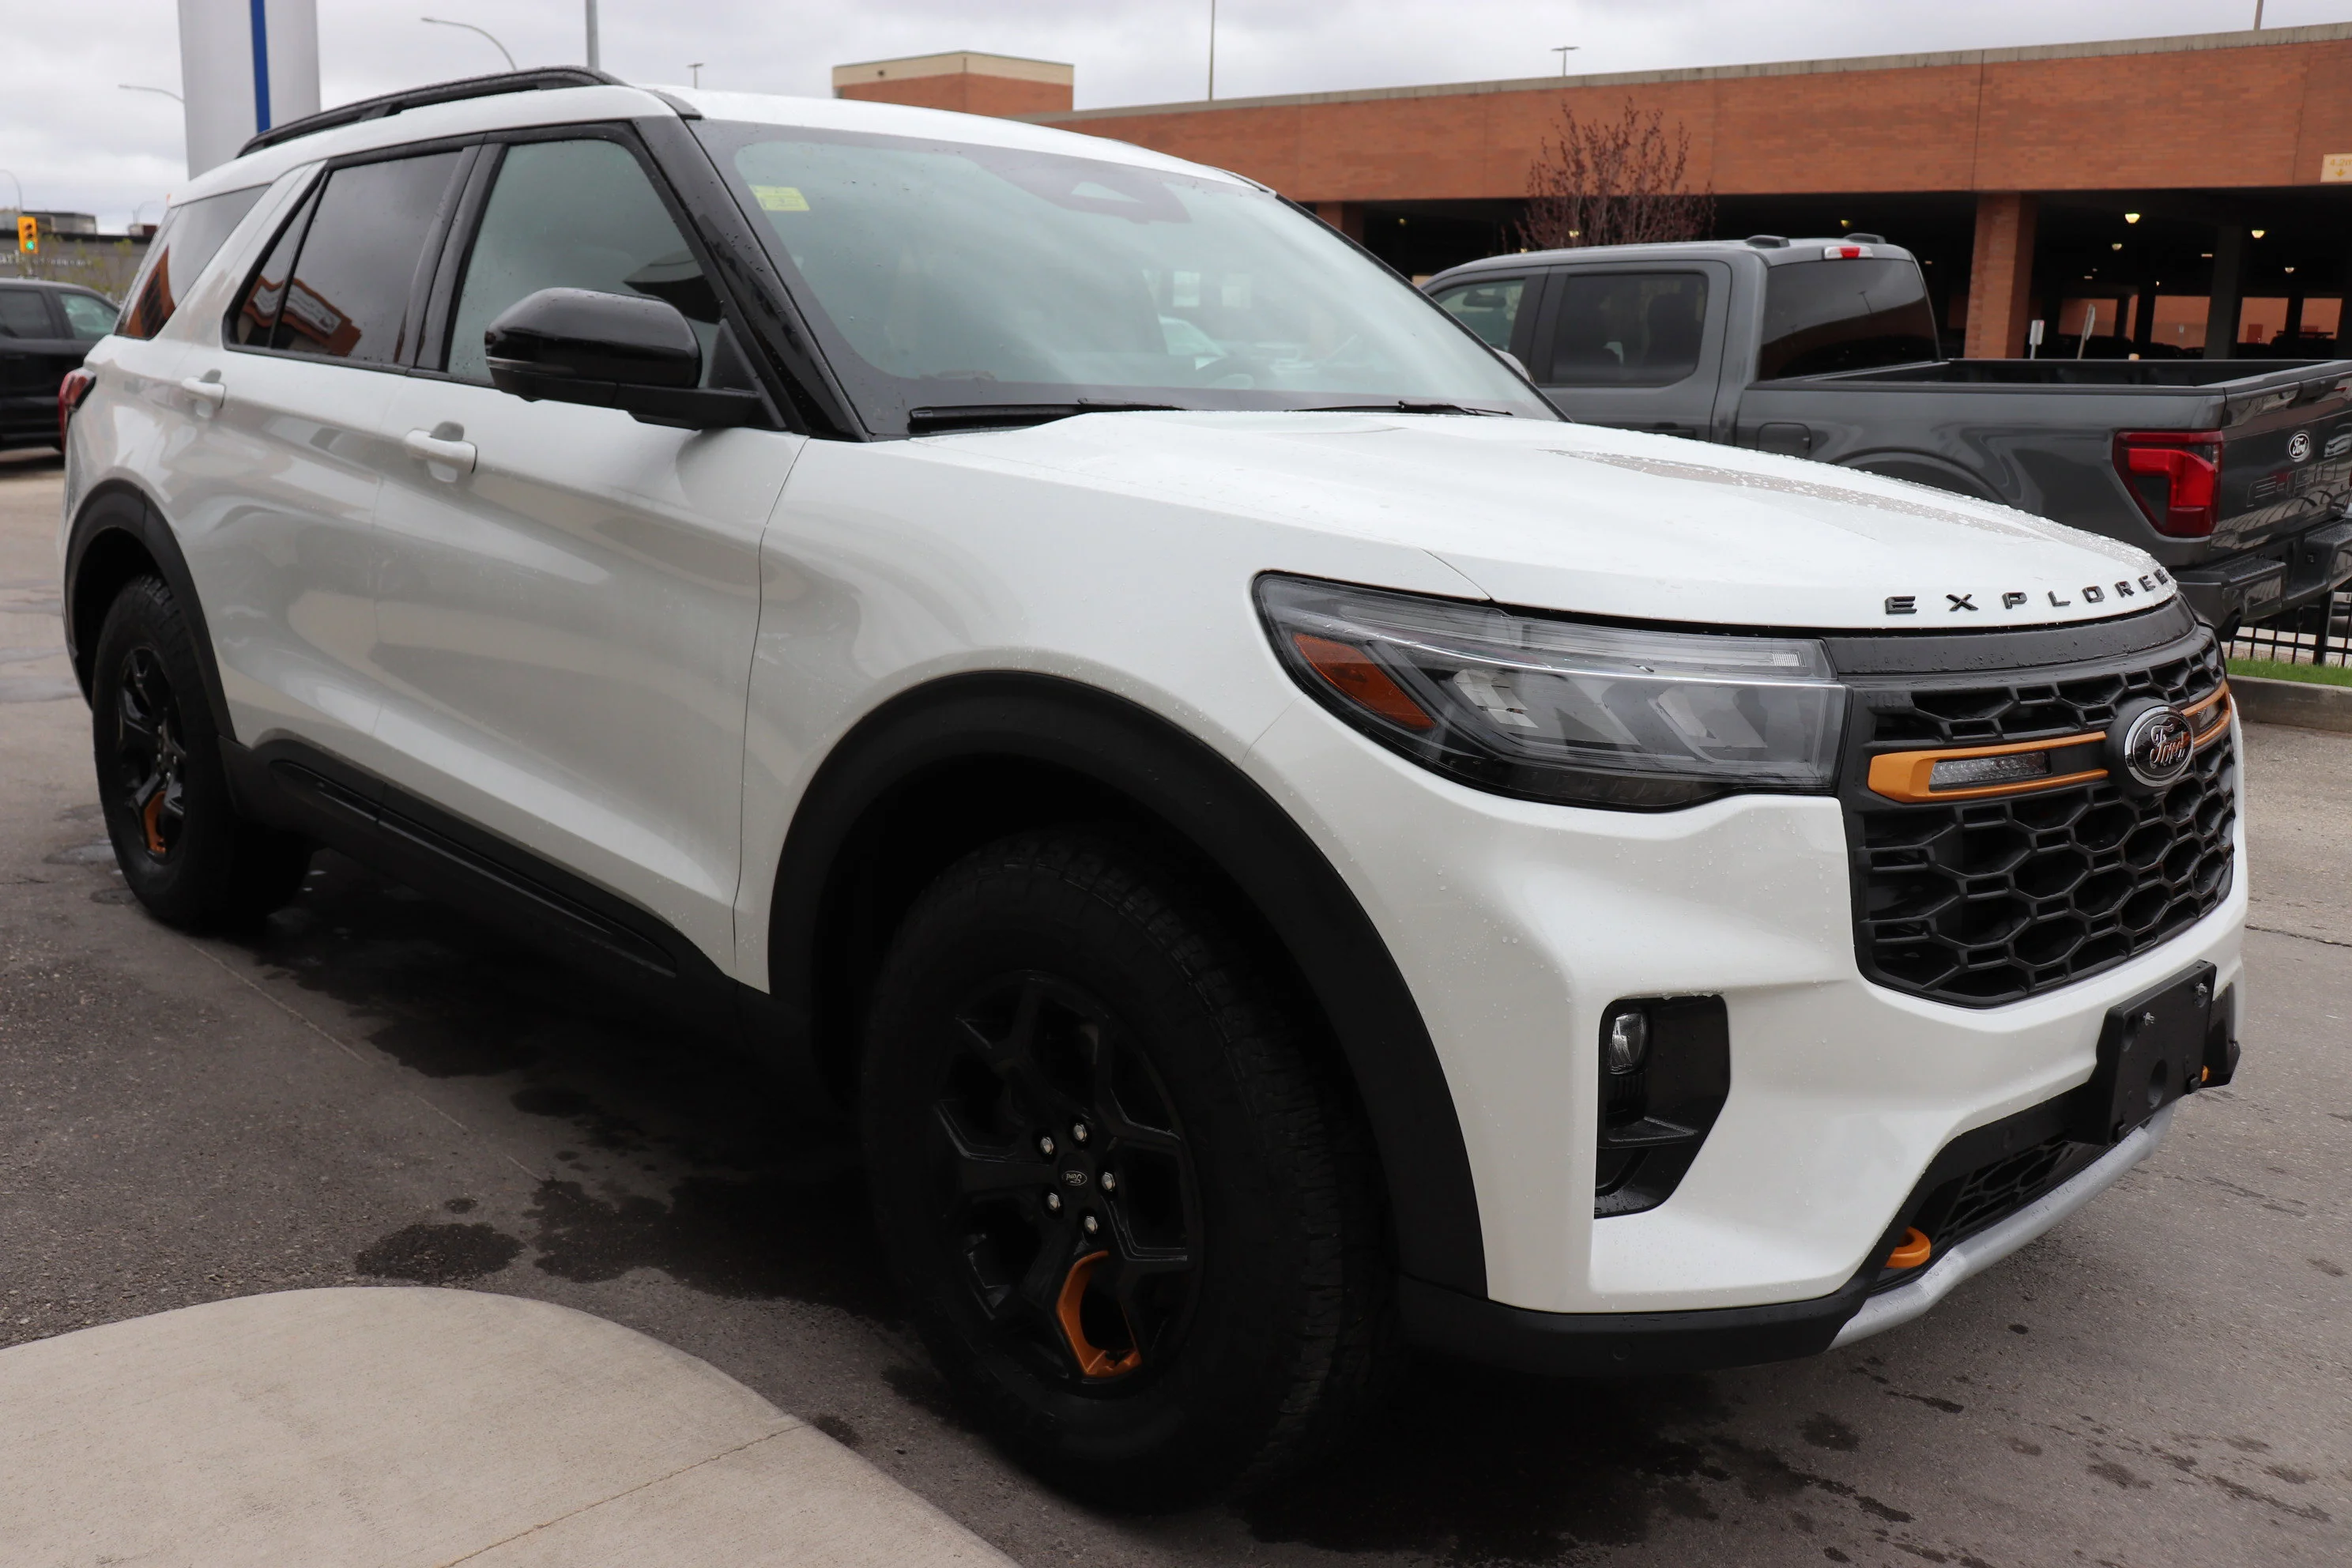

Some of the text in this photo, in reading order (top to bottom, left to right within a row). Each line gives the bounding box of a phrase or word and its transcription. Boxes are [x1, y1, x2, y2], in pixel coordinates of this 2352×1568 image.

[2292, 437, 2307, 455] Ford
[1885, 568, 2169, 615] EXPLORER
[2149, 723, 2186, 770] Ford
